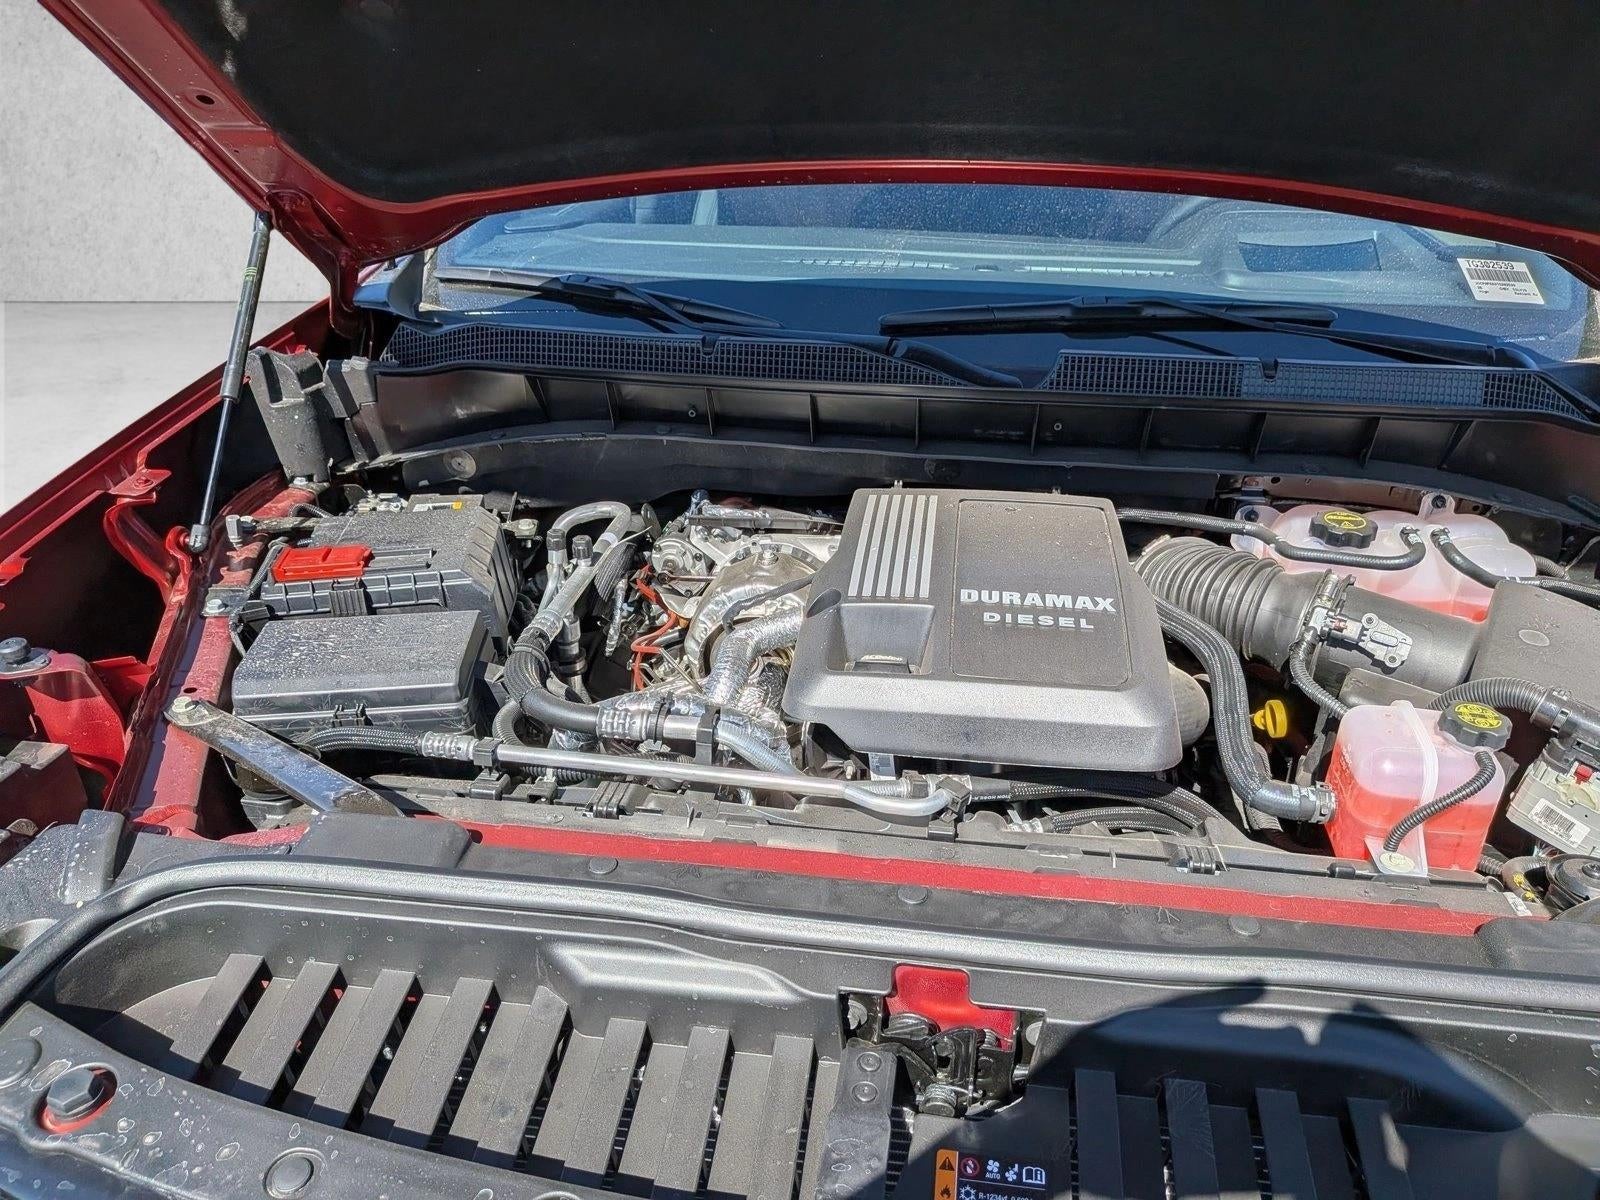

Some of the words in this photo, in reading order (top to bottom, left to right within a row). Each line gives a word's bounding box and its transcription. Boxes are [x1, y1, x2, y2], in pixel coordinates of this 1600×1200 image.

[960, 588, 1116, 612] DURAMAX
[983, 612, 1094, 629] DIESEL
[985, 1172, 1001, 1180] AUTO
